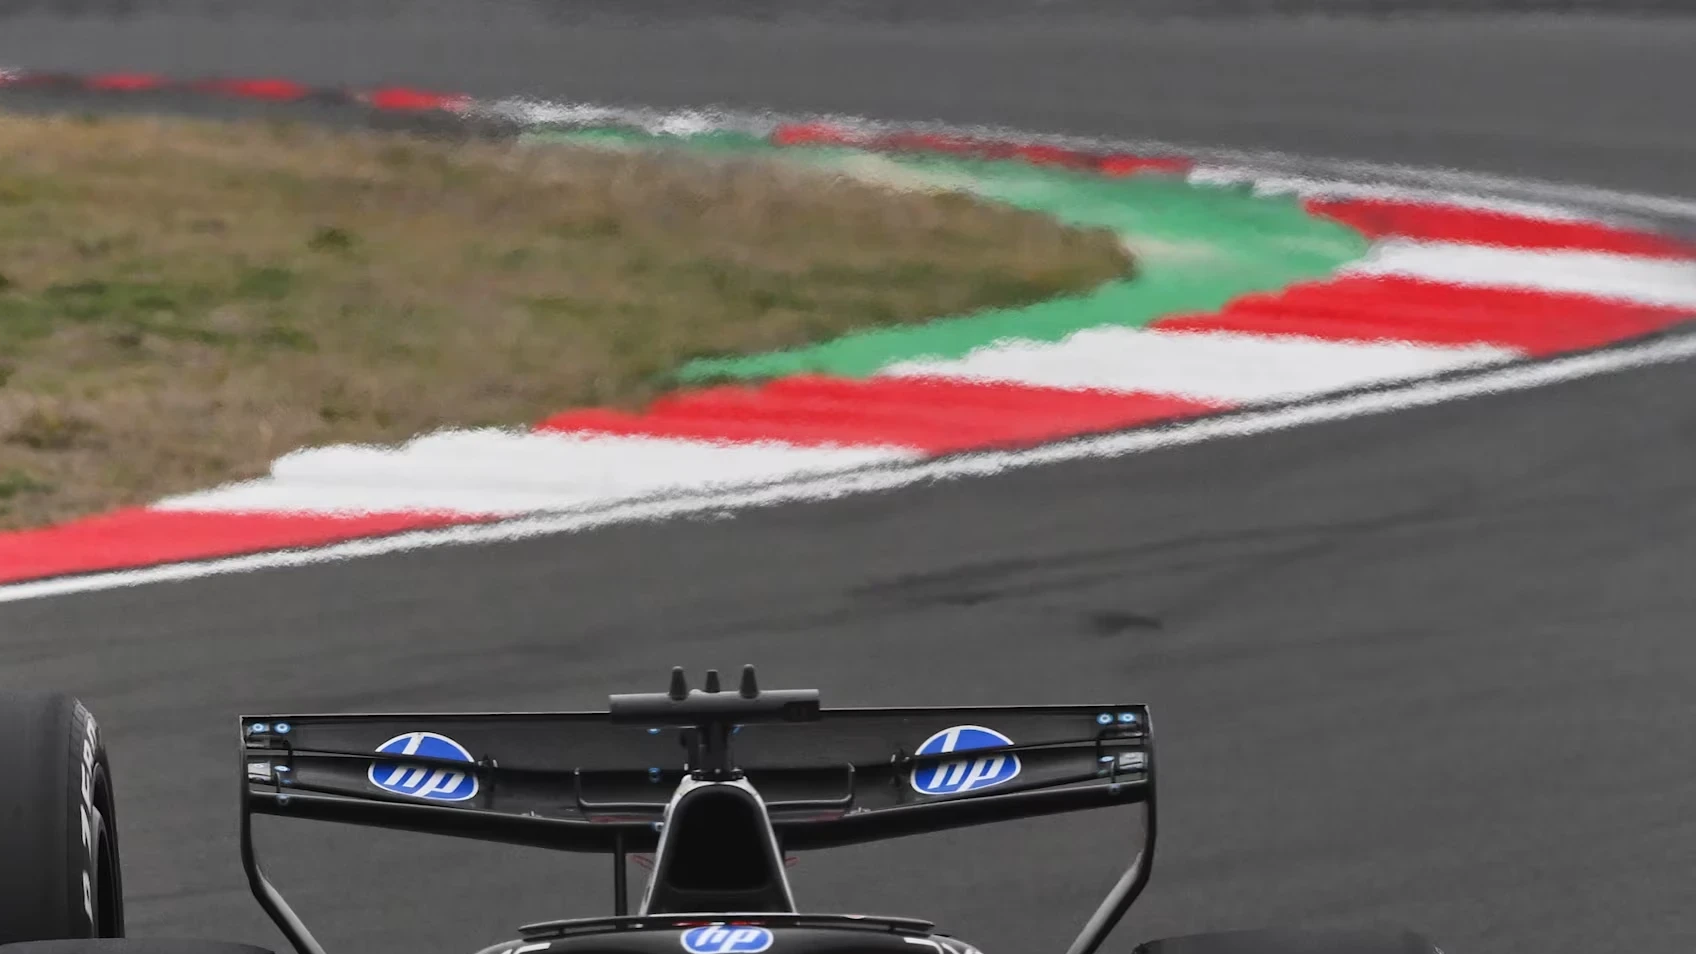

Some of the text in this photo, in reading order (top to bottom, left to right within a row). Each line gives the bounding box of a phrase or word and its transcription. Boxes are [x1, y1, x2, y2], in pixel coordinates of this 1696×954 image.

[385, 733, 465, 799] hp
[928, 726, 1007, 794] hp
[695, 926, 762, 954] hp
